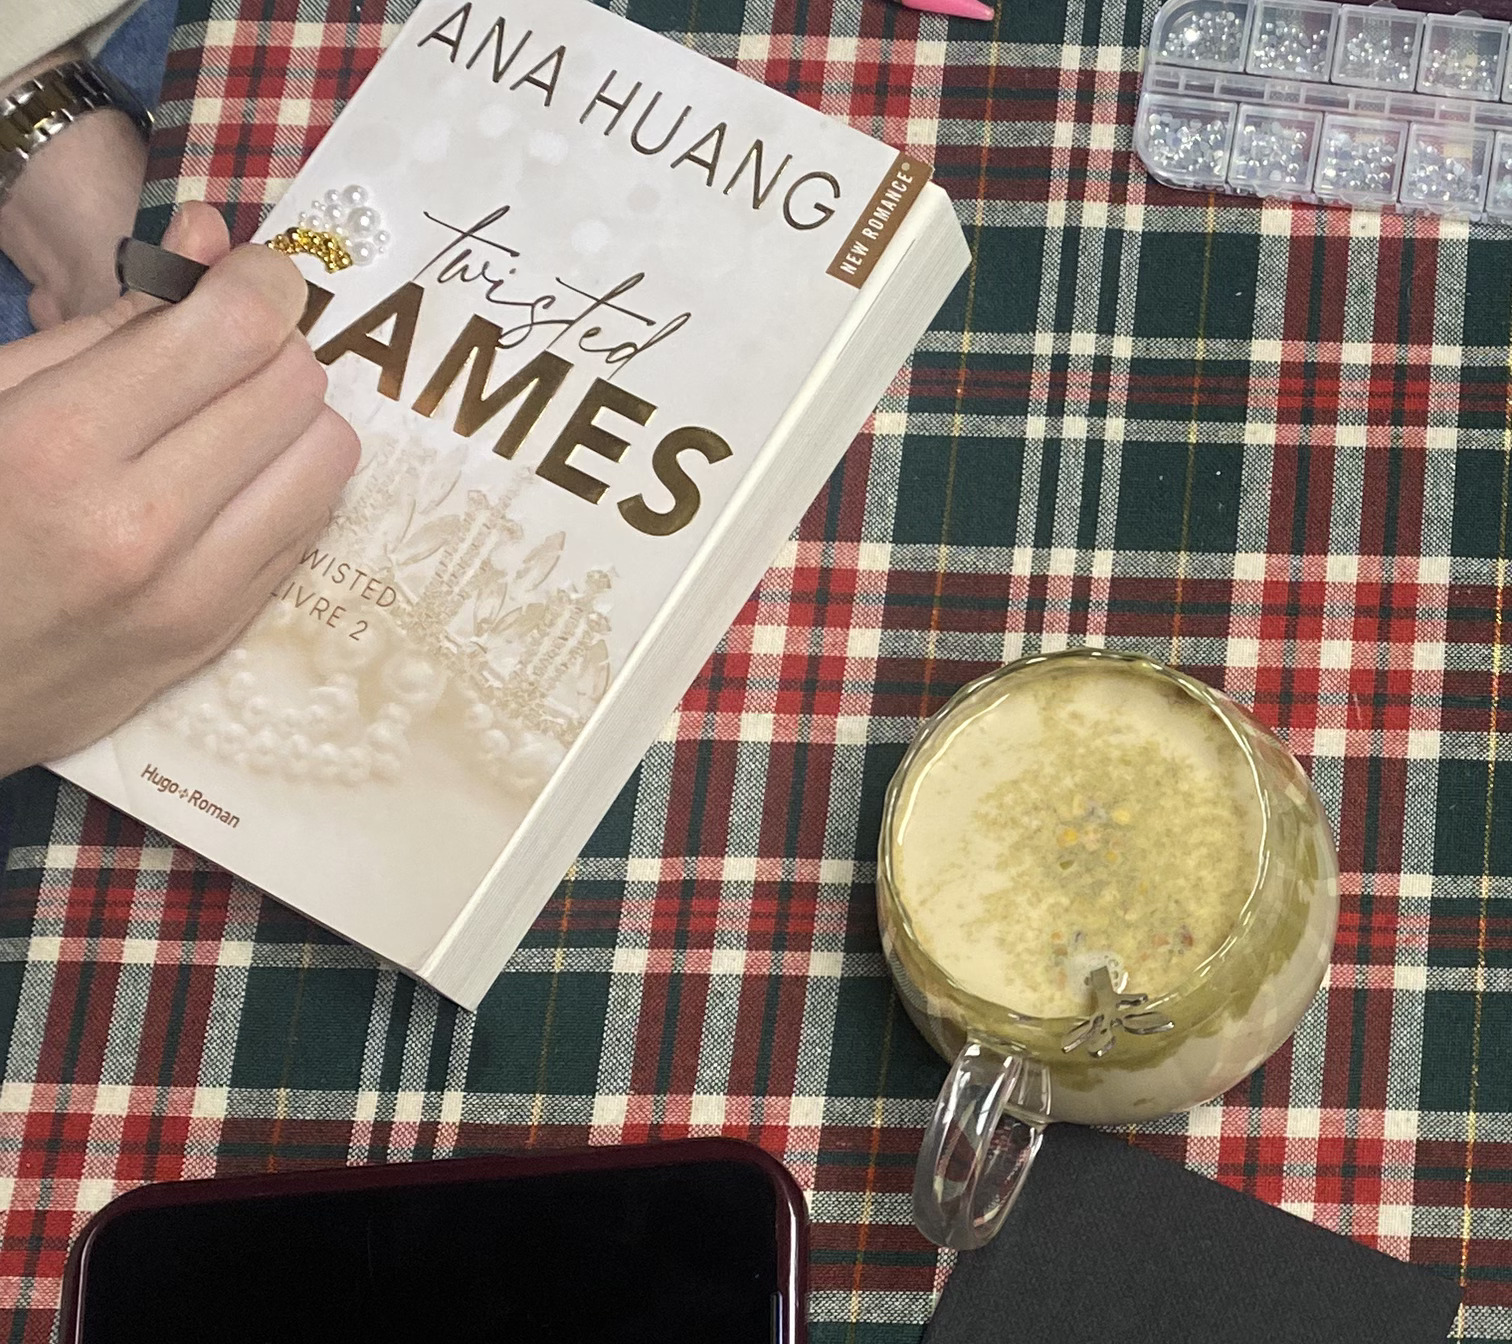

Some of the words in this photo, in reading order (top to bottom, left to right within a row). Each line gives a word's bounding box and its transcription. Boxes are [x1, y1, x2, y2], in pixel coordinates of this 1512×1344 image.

[416, 1, 567, 107] ANA
[578, 69, 842, 231] HUANG
[840, 241, 869, 275] NEW
[410, 204, 692, 380] twisted
[296, 279, 734, 537] AMES
[299, 548, 397, 608] WISTED
[270, 581, 346, 629] IVRE
[348, 619, 368, 641] 2
[187, 789, 241, 829] Roman
